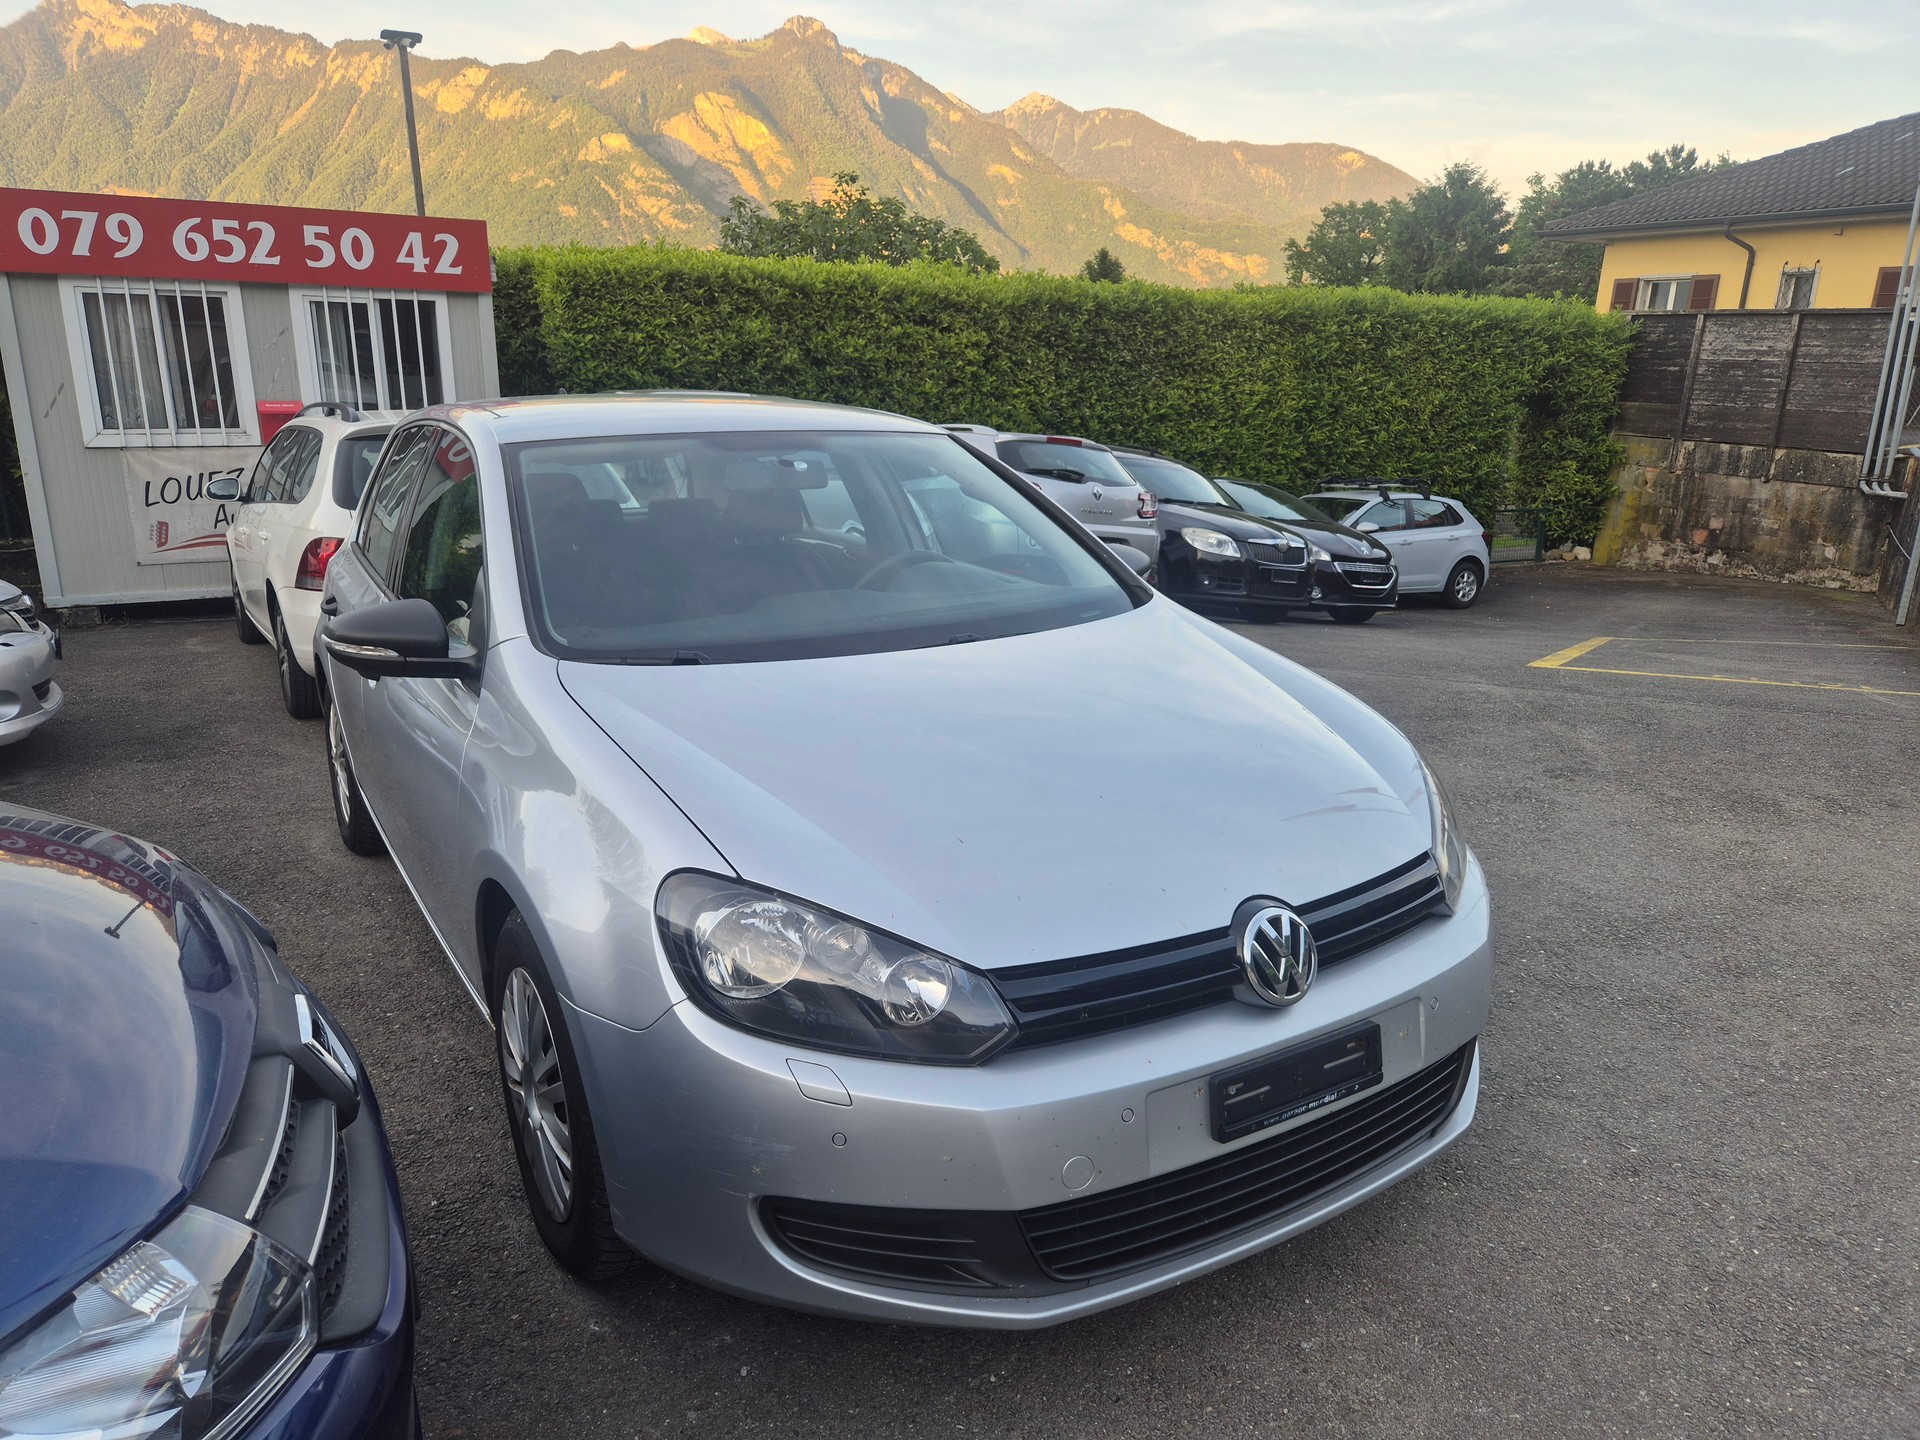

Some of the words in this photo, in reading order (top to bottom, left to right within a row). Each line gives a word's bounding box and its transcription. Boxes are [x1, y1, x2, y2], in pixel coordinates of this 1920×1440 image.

[17, 207, 144, 259] 079
[172, 217, 281, 265] 652
[303, 224, 375, 271] 50
[396, 231, 463, 275] 42
[1244, 908, 1316, 1005] VW
